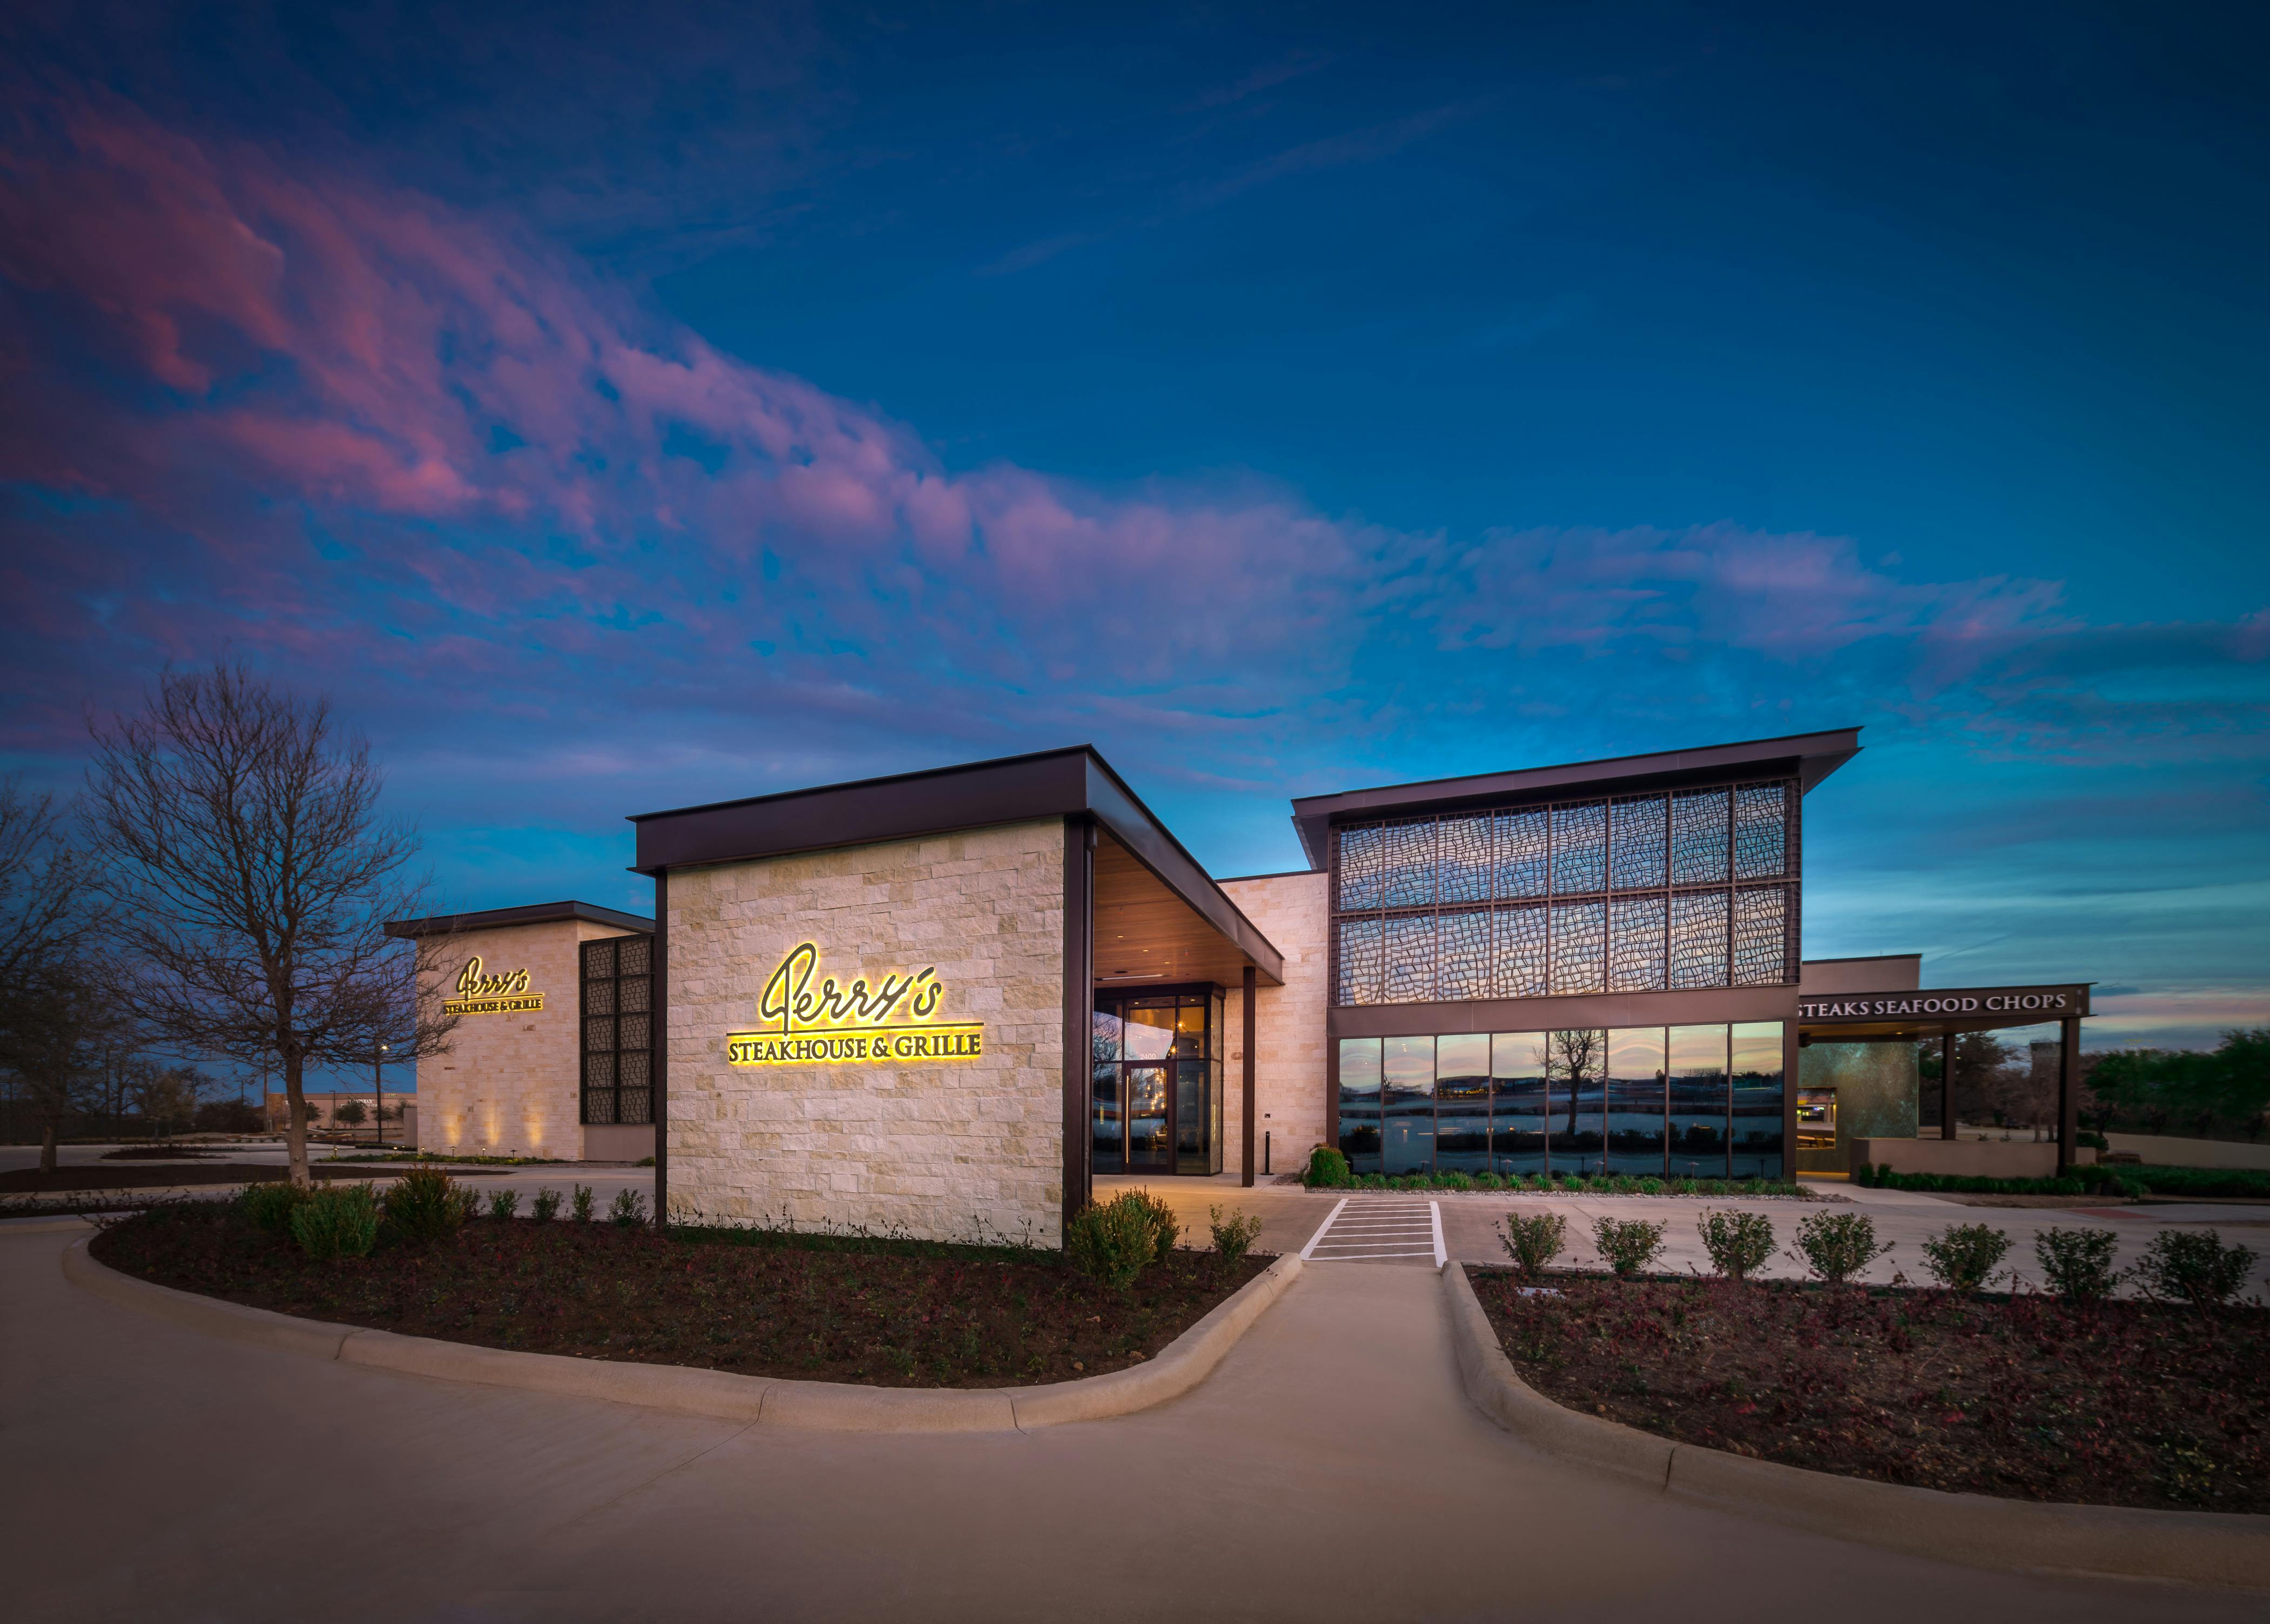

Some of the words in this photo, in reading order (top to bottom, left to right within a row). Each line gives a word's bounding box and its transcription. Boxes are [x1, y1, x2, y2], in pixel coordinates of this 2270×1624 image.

[456, 957, 528, 1001] Perry's
[760, 943, 942, 1036] Perry's
[443, 1002, 499, 1014] STEAKHOUSE
[500, 1001, 509, 1011] &
[509, 1000, 541, 1010] GRILLE
[1874, 998, 1978, 1014] SEAFOOD
[1986, 994, 2066, 1010] CHOPS
[729, 1039, 866, 1062] STEAKHOUSE
[872, 1037, 891, 1057] &
[895, 1034, 982, 1056] GRILLE
